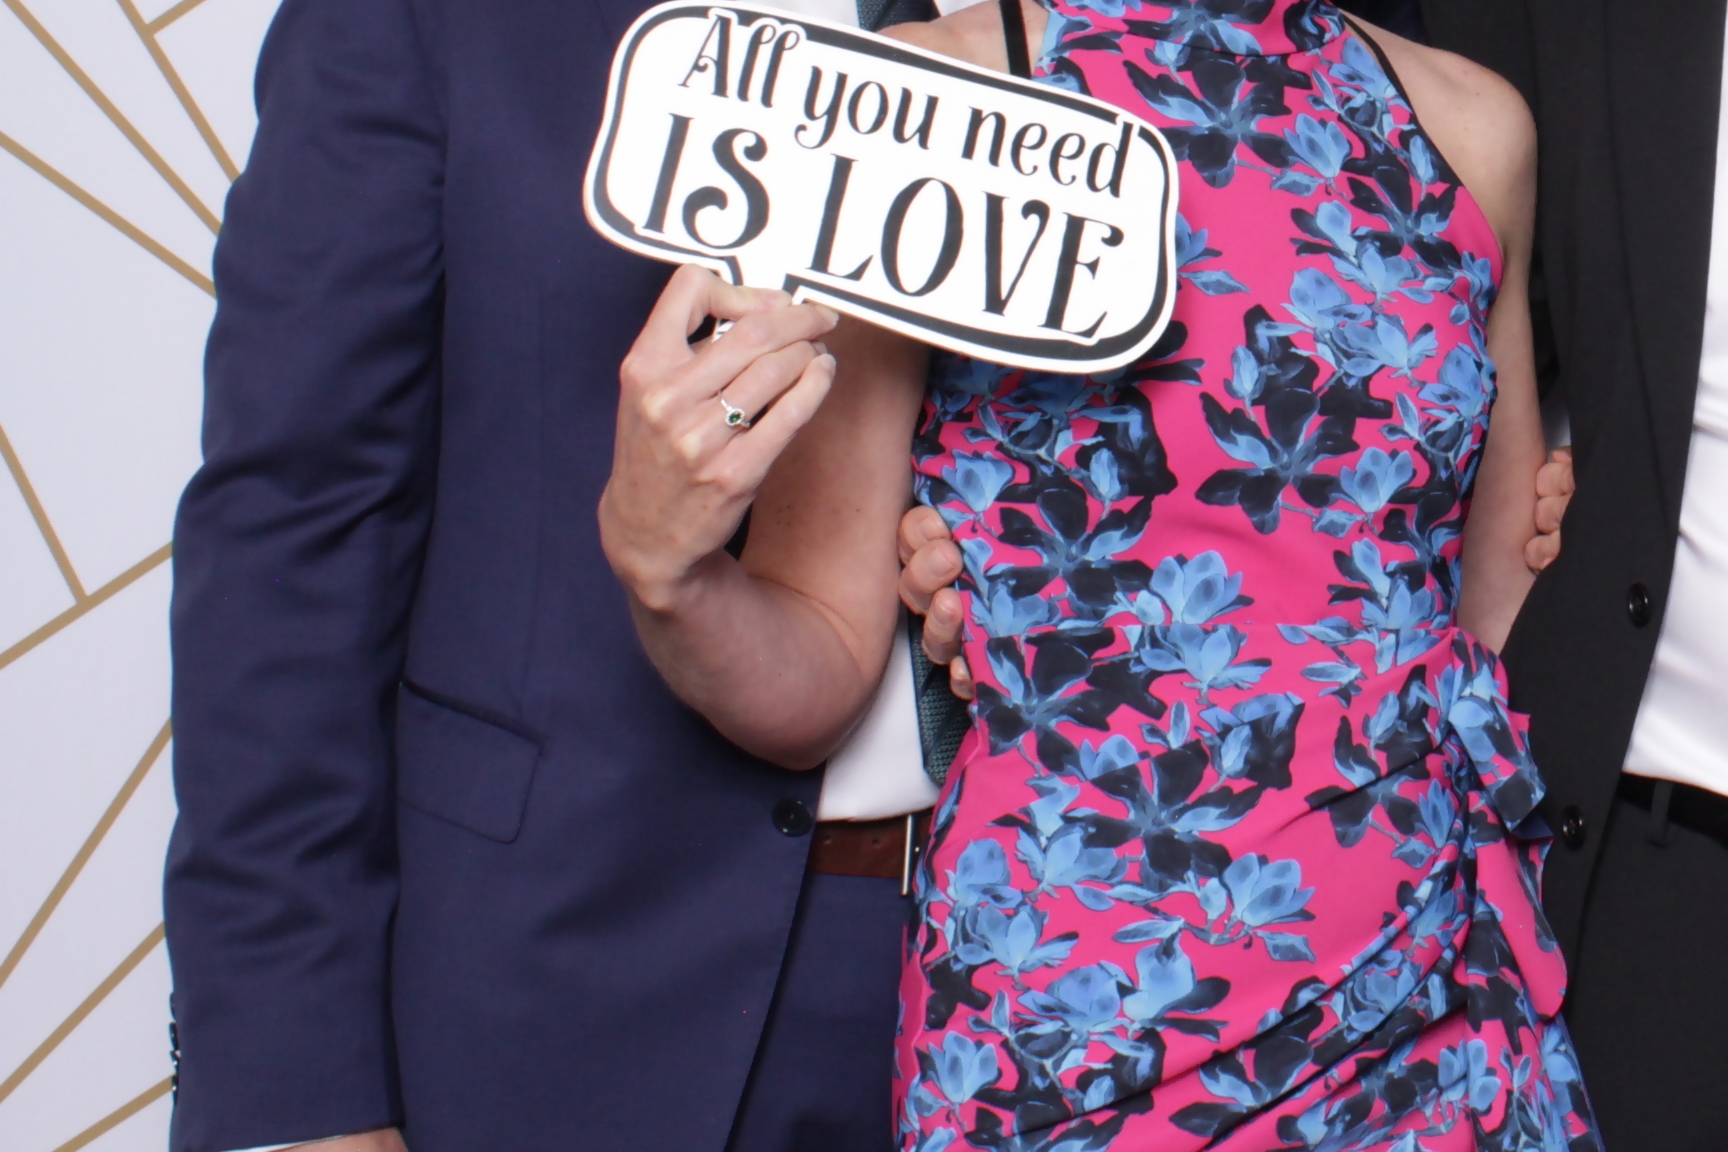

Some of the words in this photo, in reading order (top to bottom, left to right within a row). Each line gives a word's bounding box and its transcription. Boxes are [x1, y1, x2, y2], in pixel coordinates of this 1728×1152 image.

[677, 13, 800, 108] All
[794, 65, 939, 149] you
[961, 105, 1134, 199] need
[642, 112, 770, 249] IS
[805, 153, 1125, 339] LOVE
